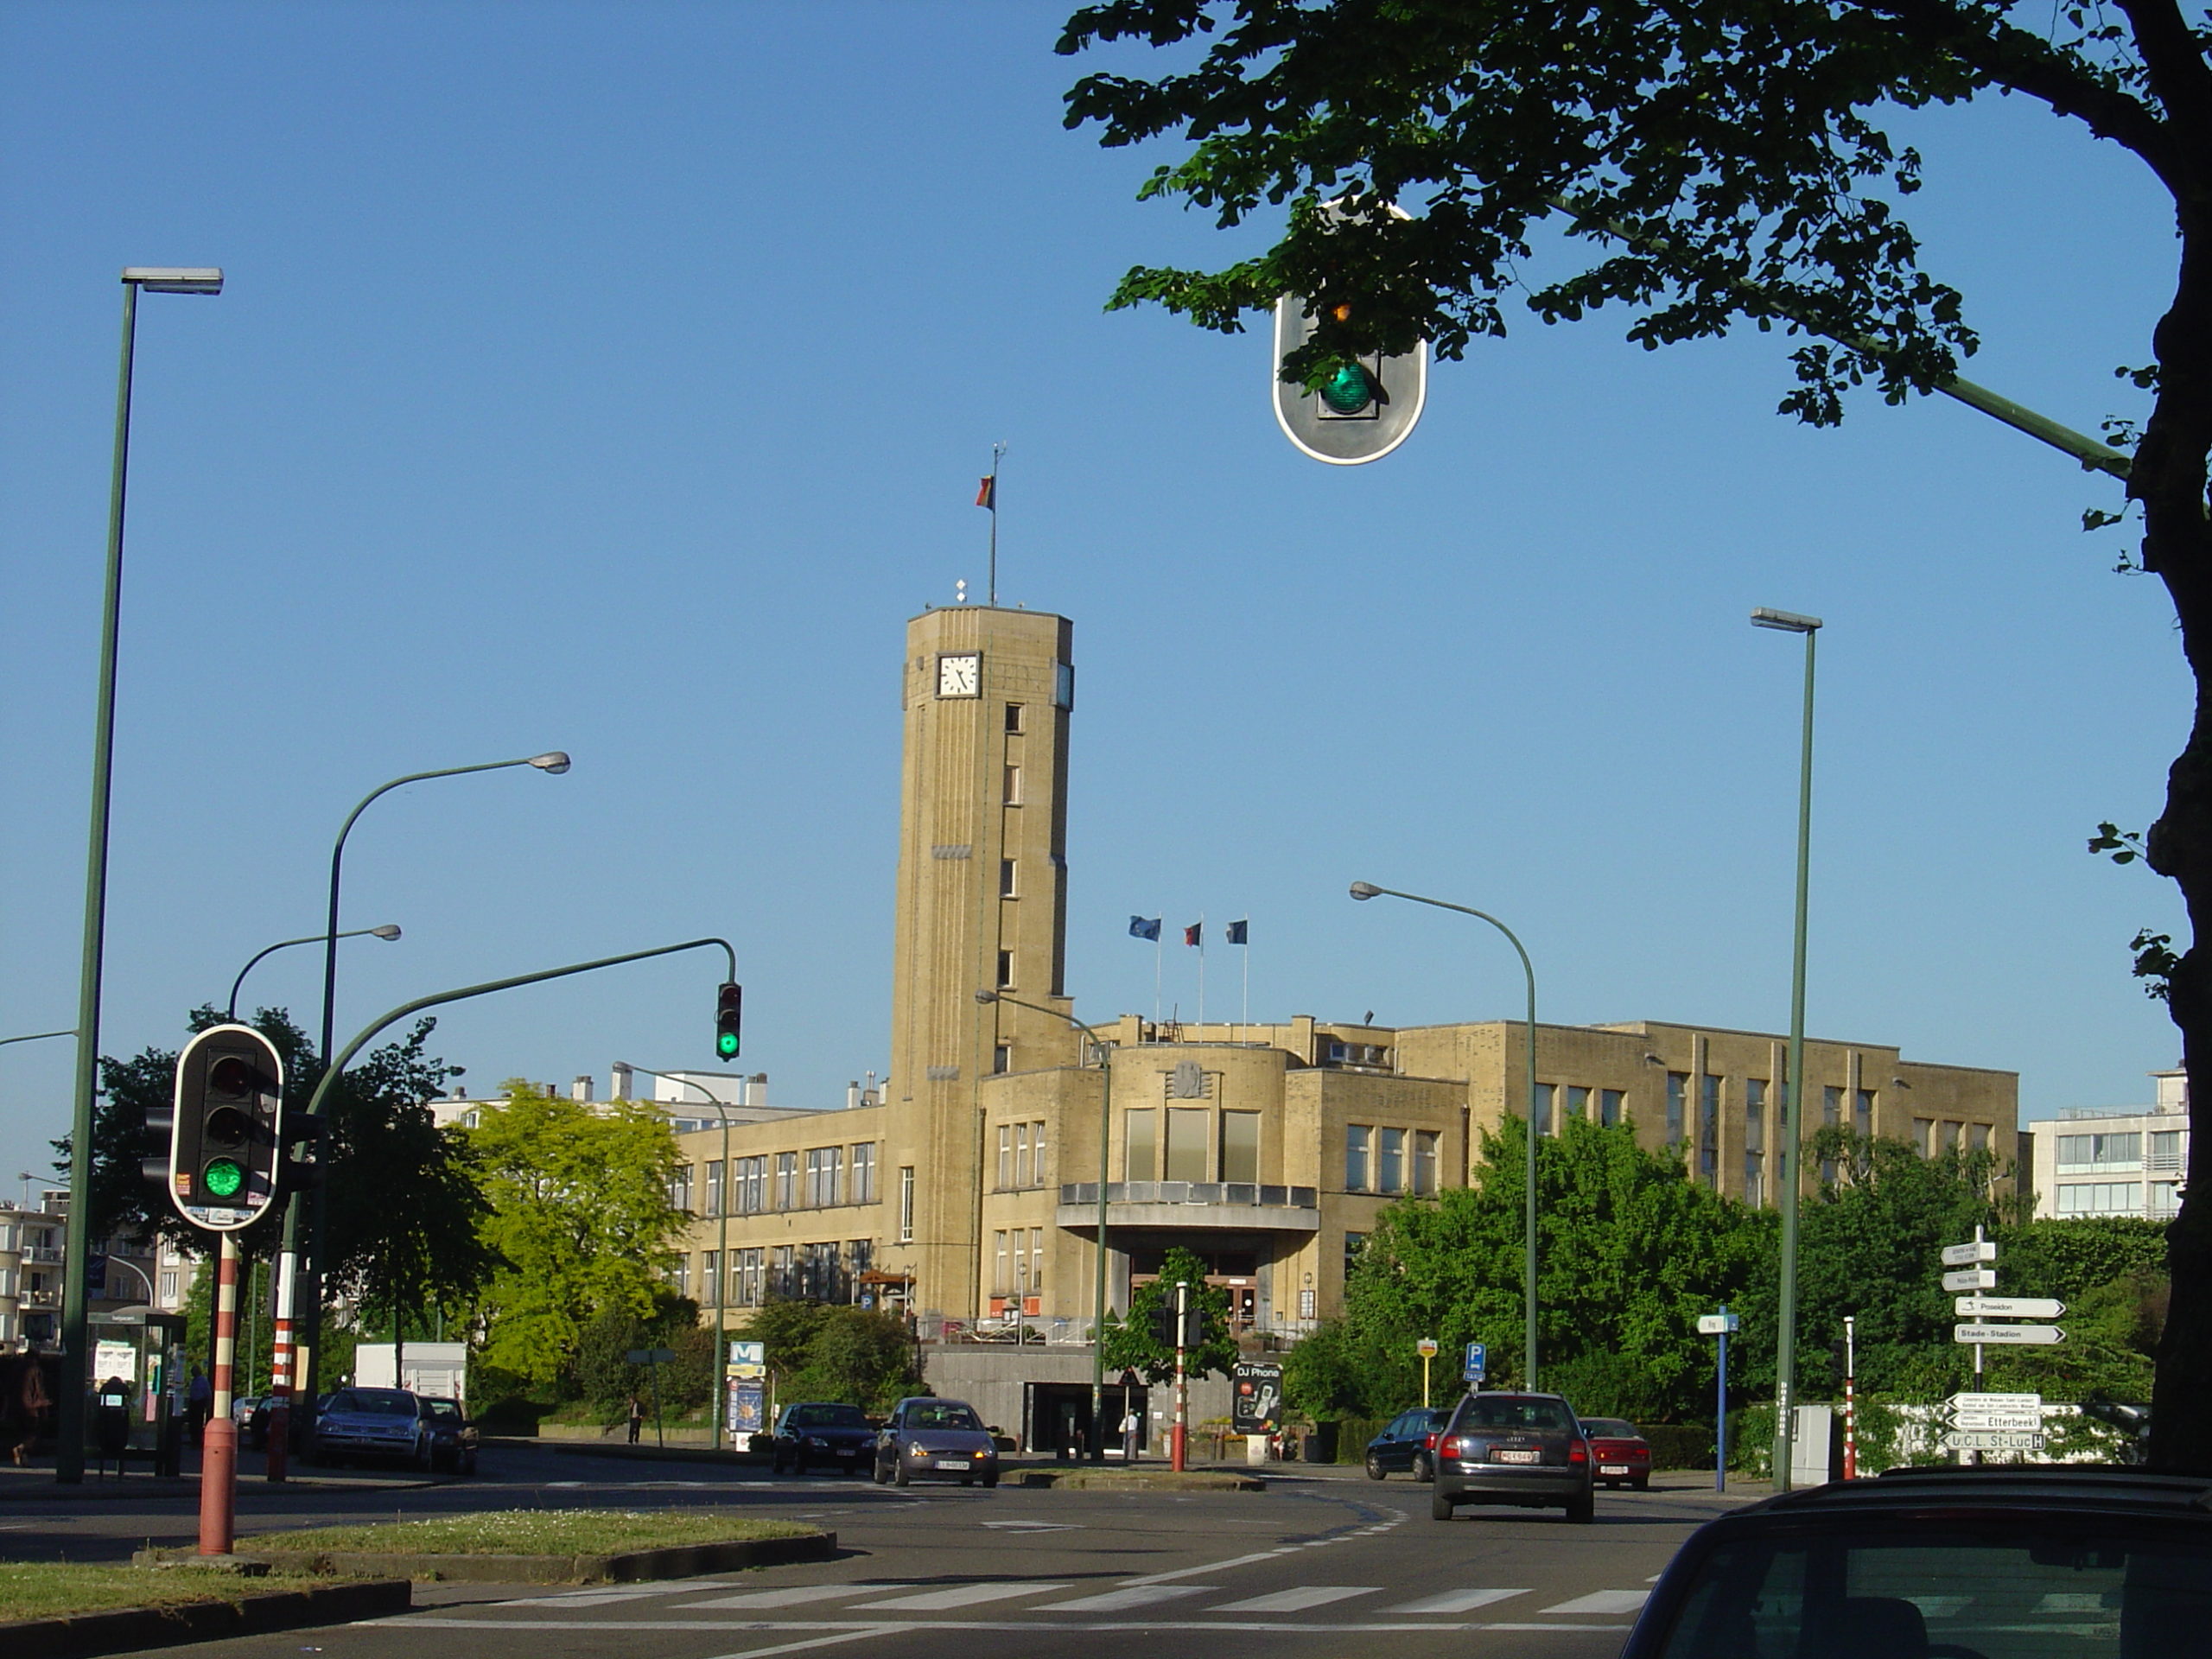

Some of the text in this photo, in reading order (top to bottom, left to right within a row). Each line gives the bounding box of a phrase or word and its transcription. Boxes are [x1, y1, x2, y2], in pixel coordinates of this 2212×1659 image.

[1980, 1302, 2013, 1311] Poseidon
[732, 1344, 761, 1362] M
[1471, 1345, 1482, 1361] P
[1236, 1367, 1280, 1377] DJ Phone
[1952, 1435, 1986, 1447] U.C.L.
[1990, 1435, 2031, 1447] St-Luc
